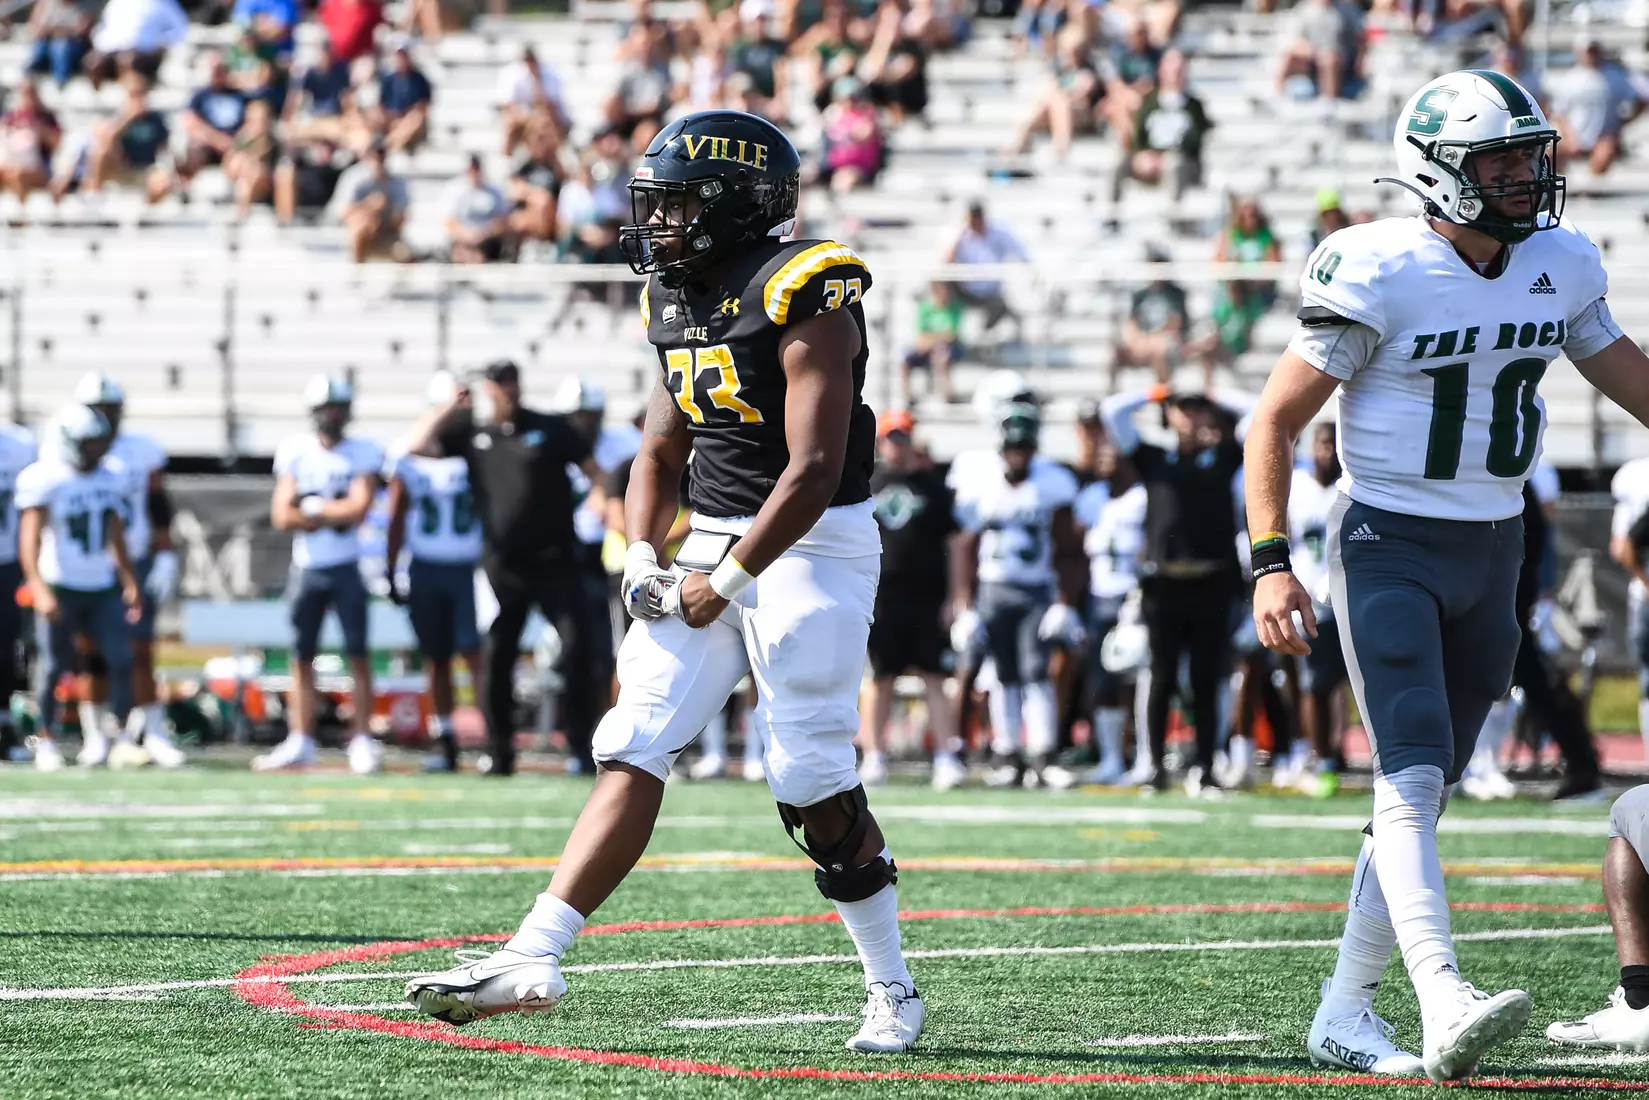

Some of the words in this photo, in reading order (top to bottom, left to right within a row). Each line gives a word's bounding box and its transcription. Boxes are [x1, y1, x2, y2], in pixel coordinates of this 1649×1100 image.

[1405, 87, 1460, 137] S
[682, 134, 768, 172] VILLE
[1309, 246, 1342, 286] 10
[1529, 285, 1557, 295] adidas
[1410, 326, 1480, 360] THE
[665, 344, 765, 424] 33
[1420, 357, 1547, 480] 10
